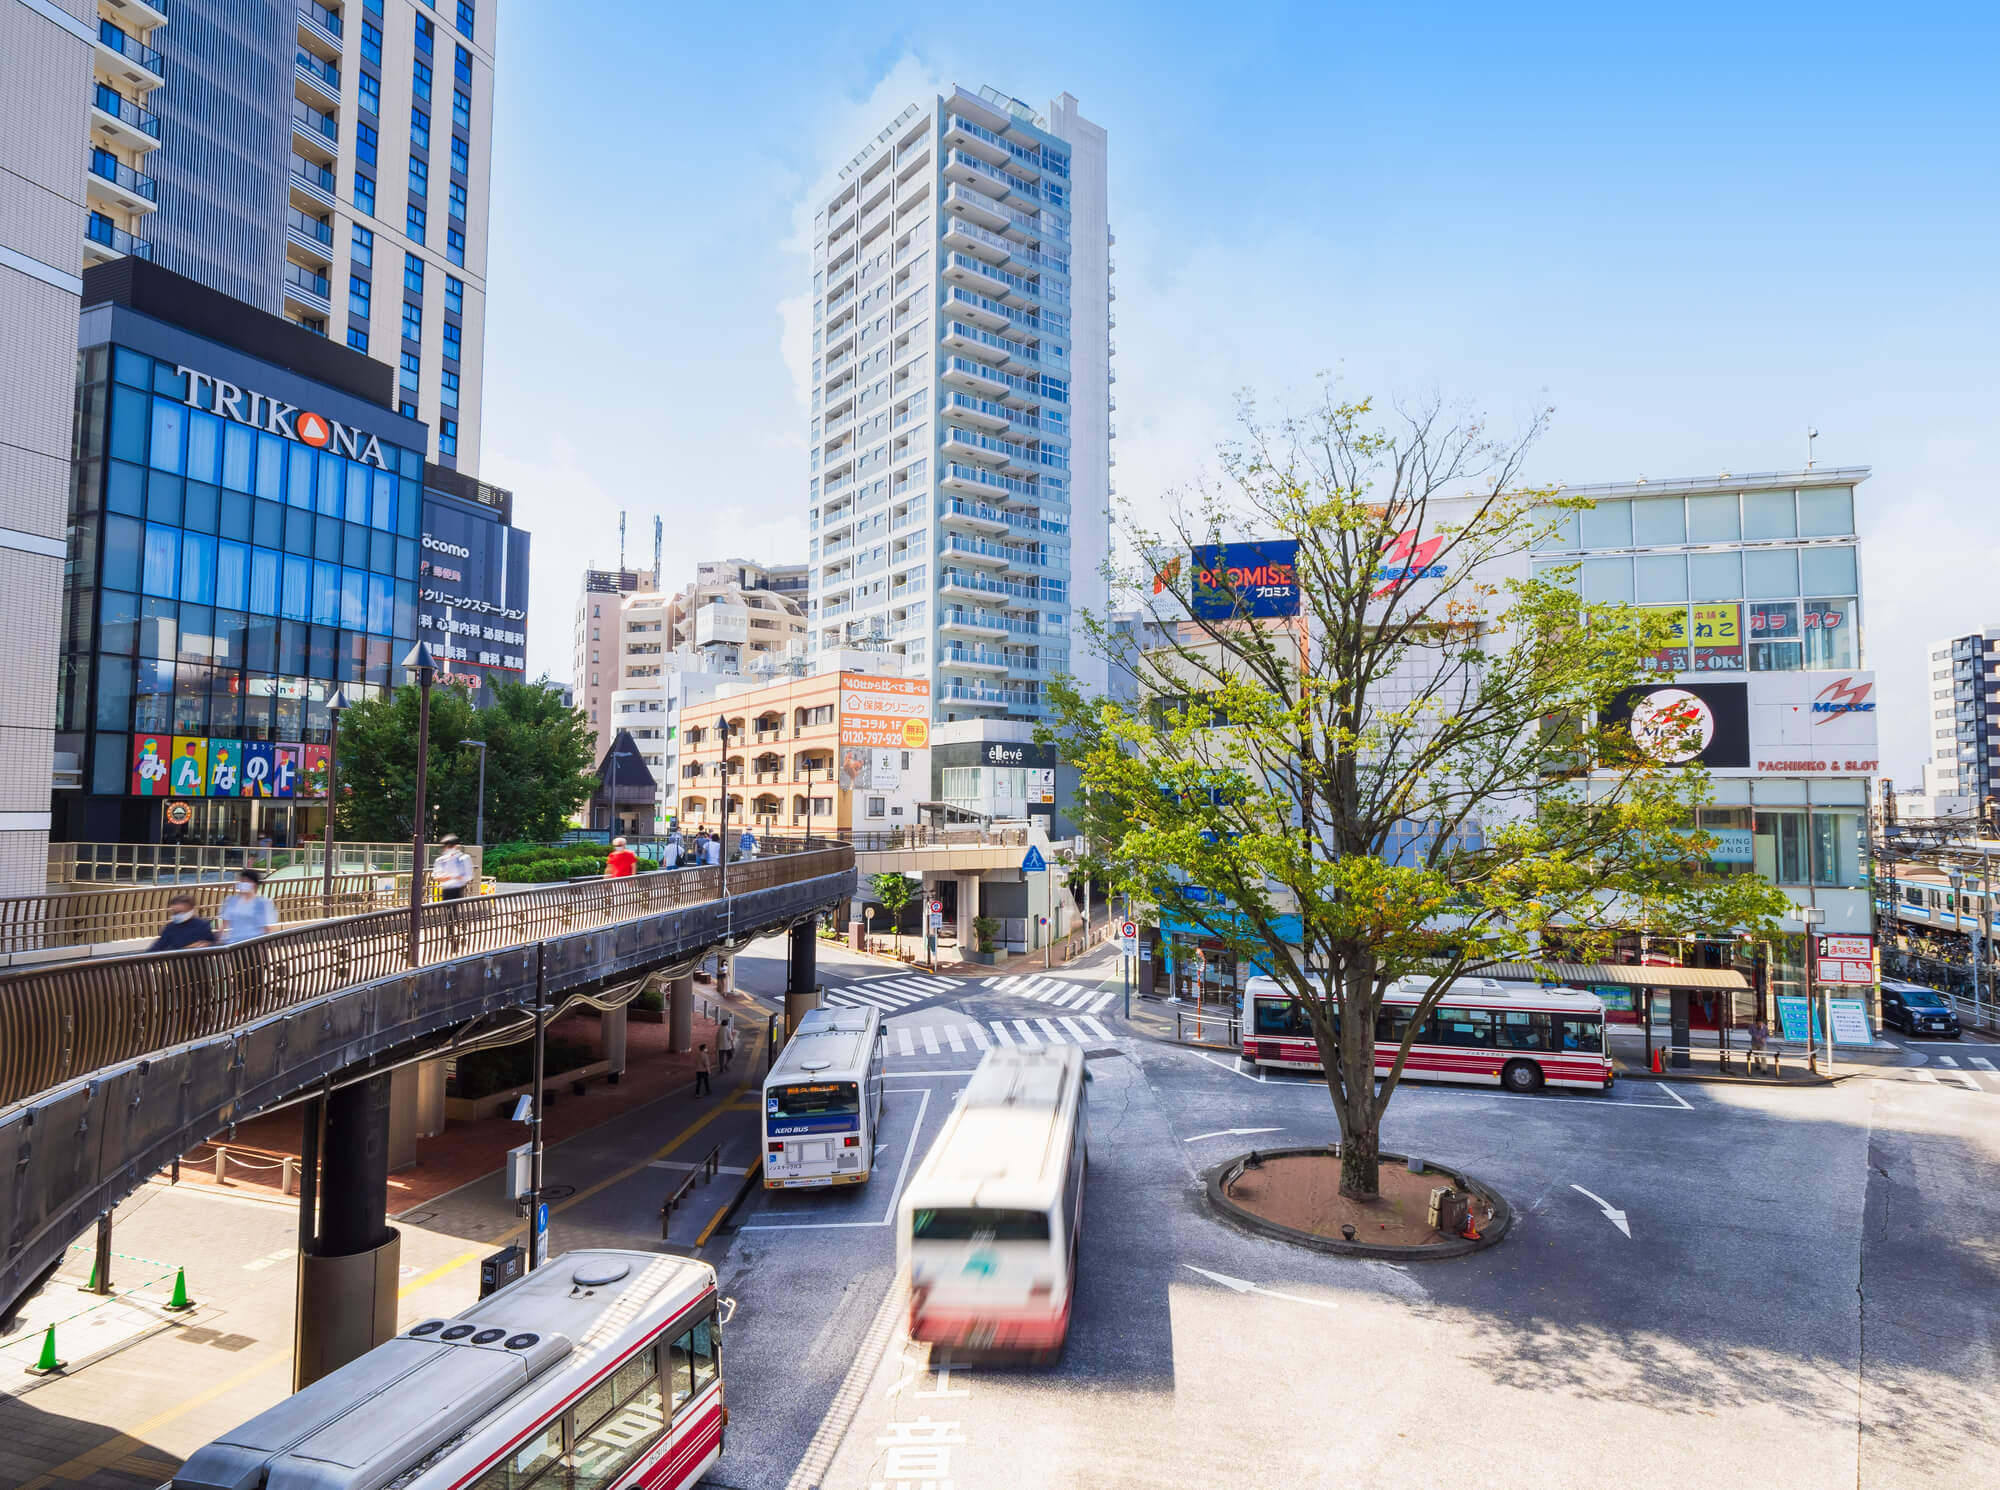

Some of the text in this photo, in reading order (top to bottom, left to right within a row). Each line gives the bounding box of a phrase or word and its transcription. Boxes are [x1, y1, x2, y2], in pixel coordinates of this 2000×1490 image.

[177, 365, 388, 470] TRIKONA
[422, 537, 470, 558] ocomo
[1371, 565, 1448, 581] esse
[1256, 586, 1291, 598] プロミス
[424, 588, 525, 620] クリニックステーション
[890, 719, 903, 730] 1F
[842, 730, 903, 745] 0120-797-929
[141, 754, 298, 791] みんなのト
[1758, 760, 1879, 772] PACHINKO & SLOT
